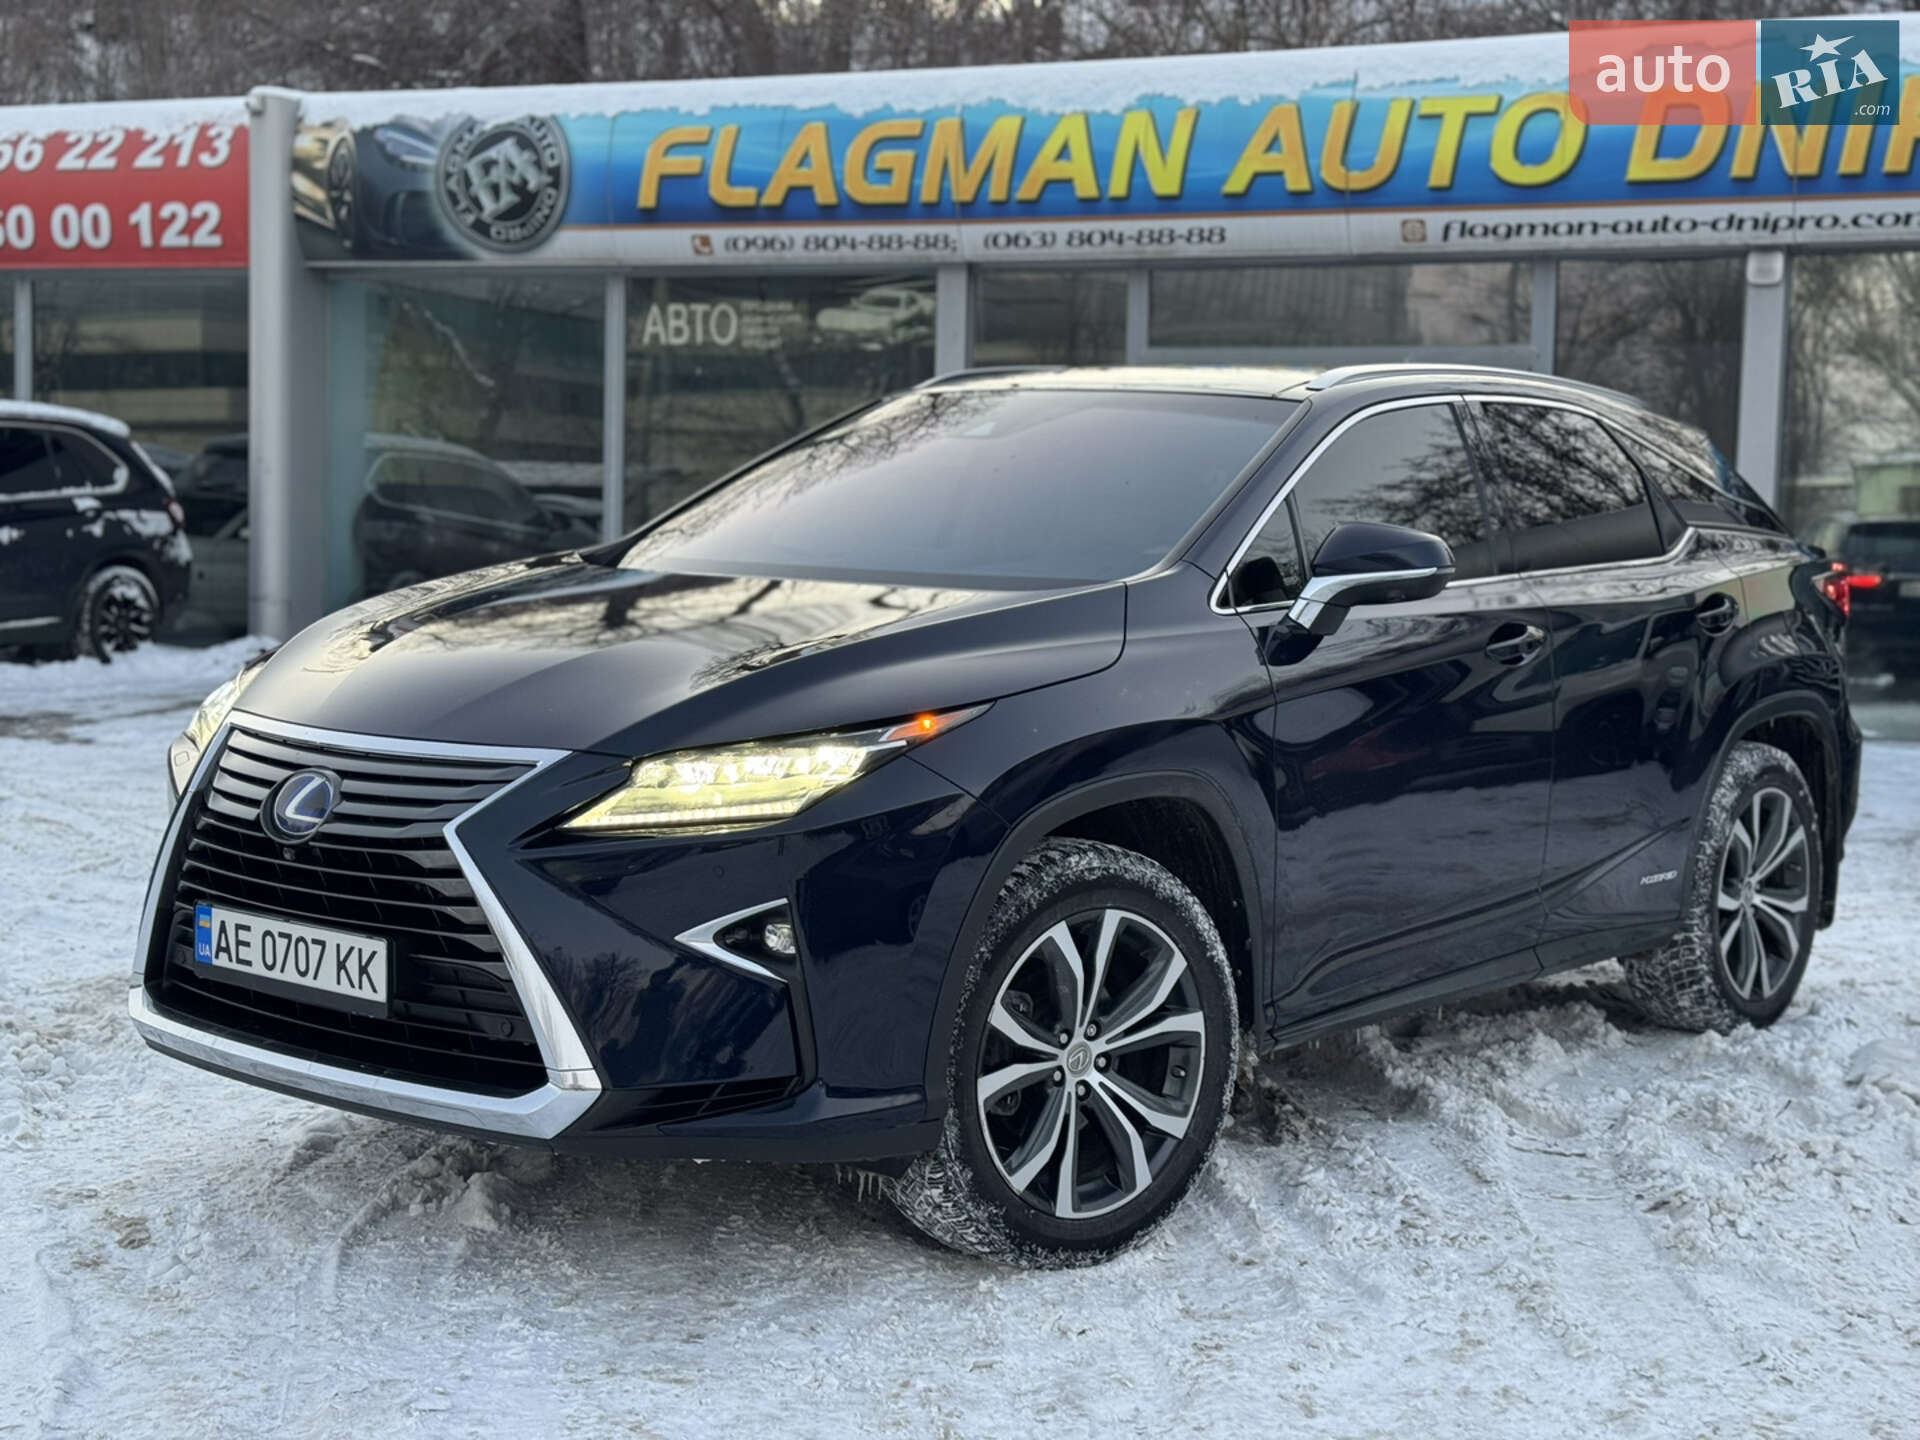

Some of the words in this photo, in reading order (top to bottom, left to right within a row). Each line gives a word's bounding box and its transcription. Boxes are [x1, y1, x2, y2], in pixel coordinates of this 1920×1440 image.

[56, 126, 125, 170] 22
[132, 124, 233, 168] 213
[637, 107, 1198, 208] FLAGMAN
[1220, 91, 1588, 194] AUTO
[0, 202, 35, 250] 0
[51, 202, 111, 250] 00
[129, 201, 223, 249] 122
[724, 234, 794, 251] (096)
[983, 230, 1057, 249] (063)
[1065, 226, 1227, 248] 804-88-88
[642, 302, 738, 346] АВТО
[198, 943, 212, 957] UA
[214, 919, 253, 968] AE
[261, 929, 327, 981] 0707
[335, 942, 379, 995] KK
